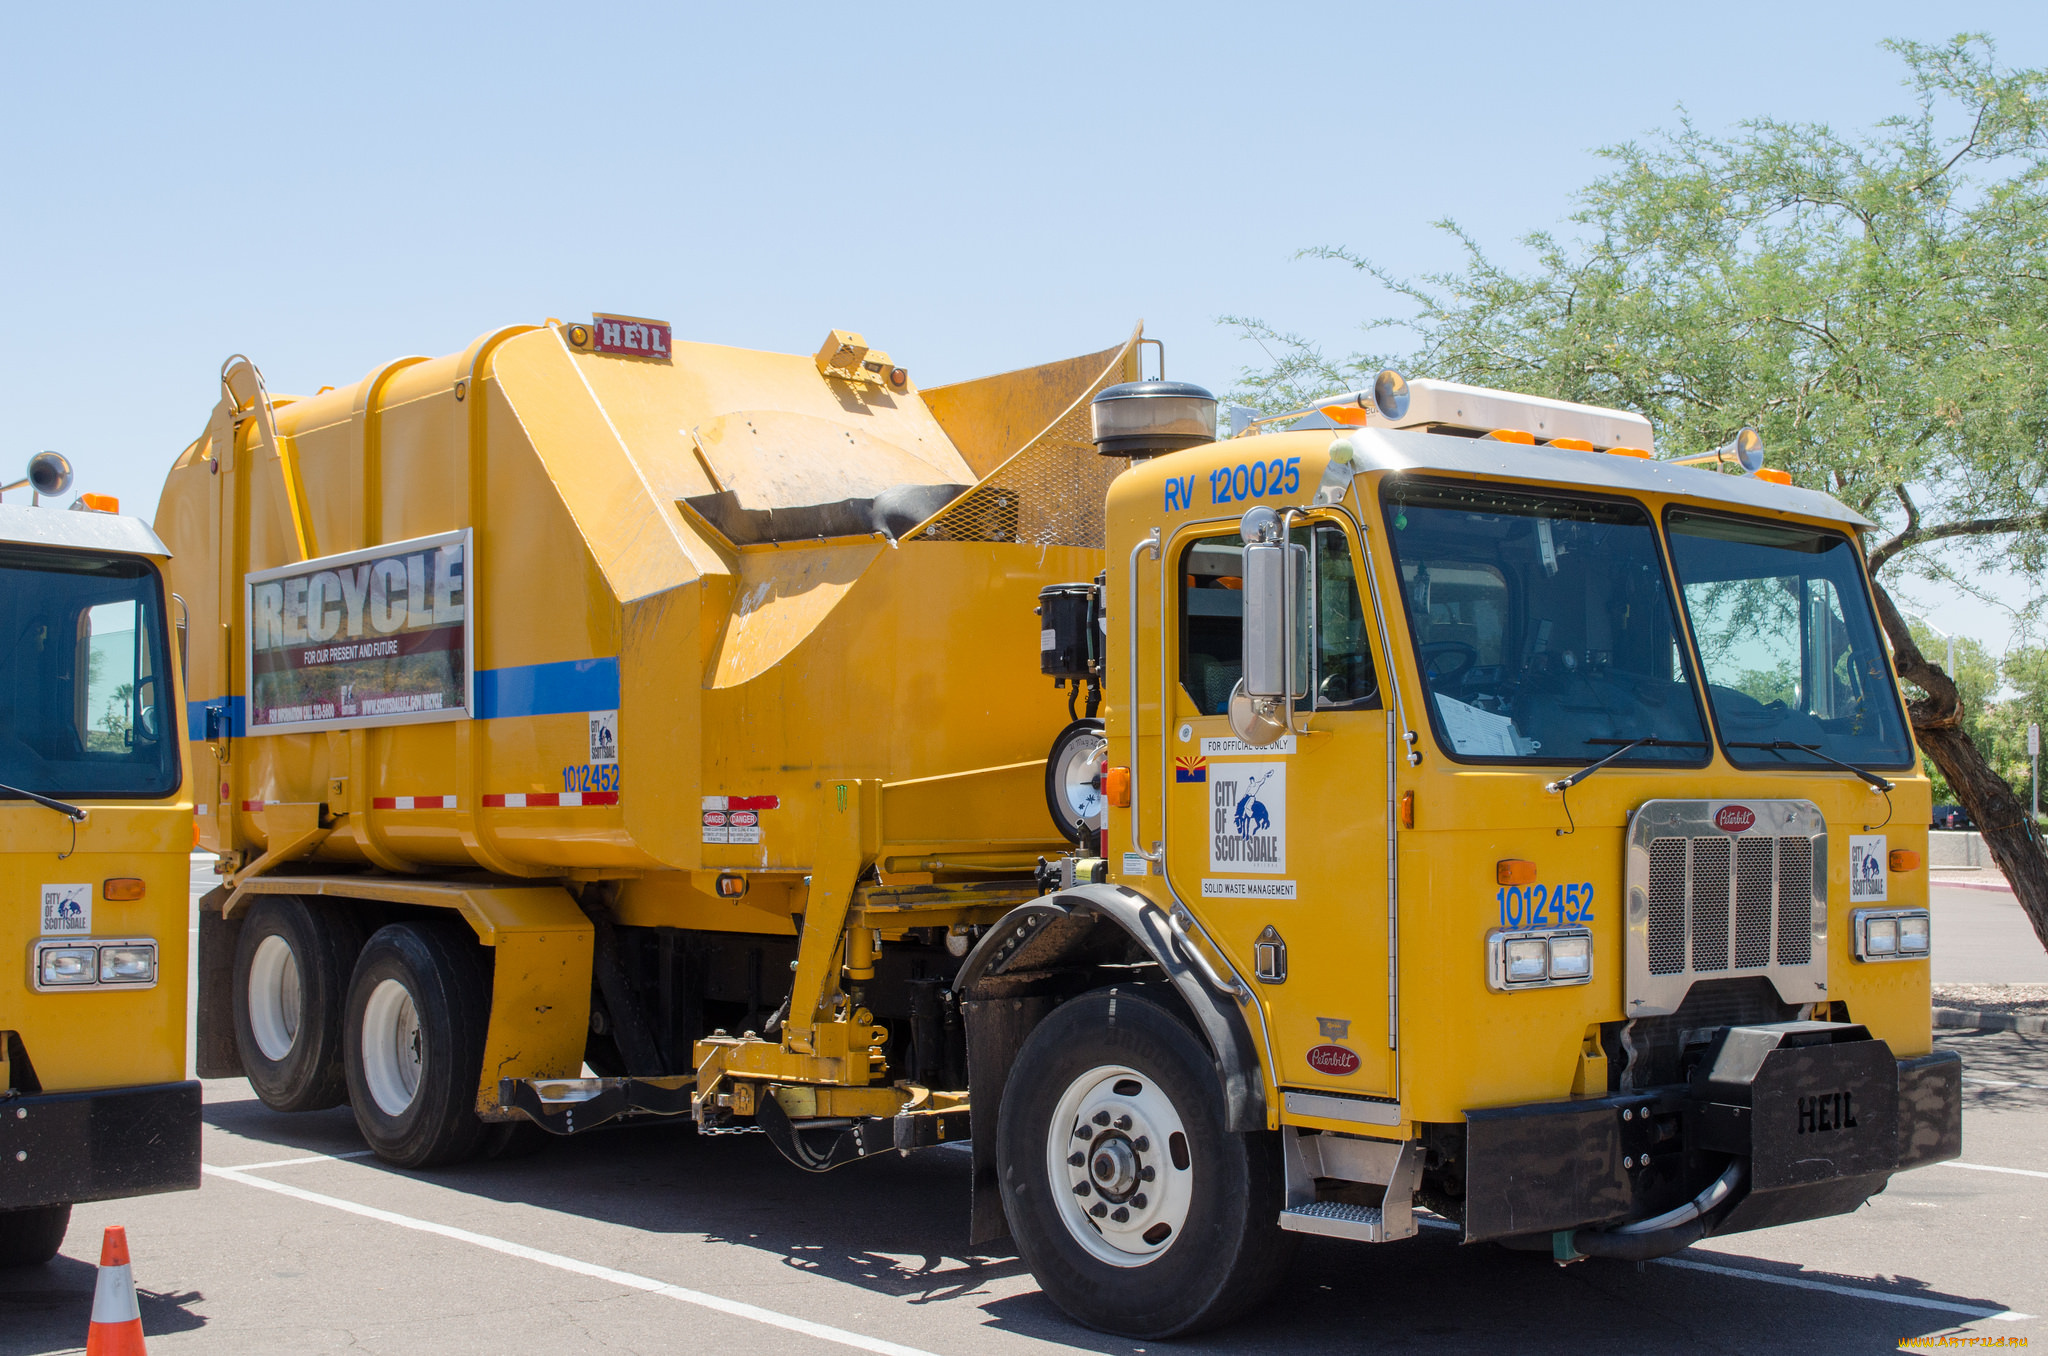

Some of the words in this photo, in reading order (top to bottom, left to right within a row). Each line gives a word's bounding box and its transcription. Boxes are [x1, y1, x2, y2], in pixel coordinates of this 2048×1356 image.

[602, 322, 666, 352] HEIL
[1164, 474, 1196, 512] RV
[1209, 456, 1301, 505] 120025
[255, 545, 464, 650] RECYCLE
[304, 651, 316, 664] FOR
[316, 649, 329, 663] OUR
[330, 645, 358, 661] PRESENT
[359, 643, 373, 658] AND
[373, 640, 398, 656] FUTURE
[591, 720, 600, 733] CITY
[591, 734, 597, 746] OF
[1208, 741, 1221, 751] FOR
[591, 746, 616, 760] SCOTTSDALE
[562, 763, 619, 793] 1012452
[1214, 780, 1238, 807] CITY
[705, 815, 725, 824] DANGER
[732, 815, 755, 824] DANGER
[1214, 808, 1227, 835] OF
[1720, 809, 1753, 826] Peterbilt
[1214, 835, 1278, 863] SCOTTSDALE
[1851, 846, 1864, 862] CITY
[1852, 863, 1859, 878] OF
[1204, 883, 1223, 894] SOLID
[1225, 883, 1246, 894] WASTE
[1247, 884, 1294, 895] MANAGEMENT
[1852, 879, 1884, 896] SCOTTSDALE
[45, 892, 61, 905] CITY
[1496, 882, 1594, 927] 1012452
[45, 905, 53, 917] OF
[44, 917, 86, 930] SCOTTSDALE
[1311, 1048, 1355, 1068] Peterbilt
[1797, 1091, 1858, 1135] HEIL
